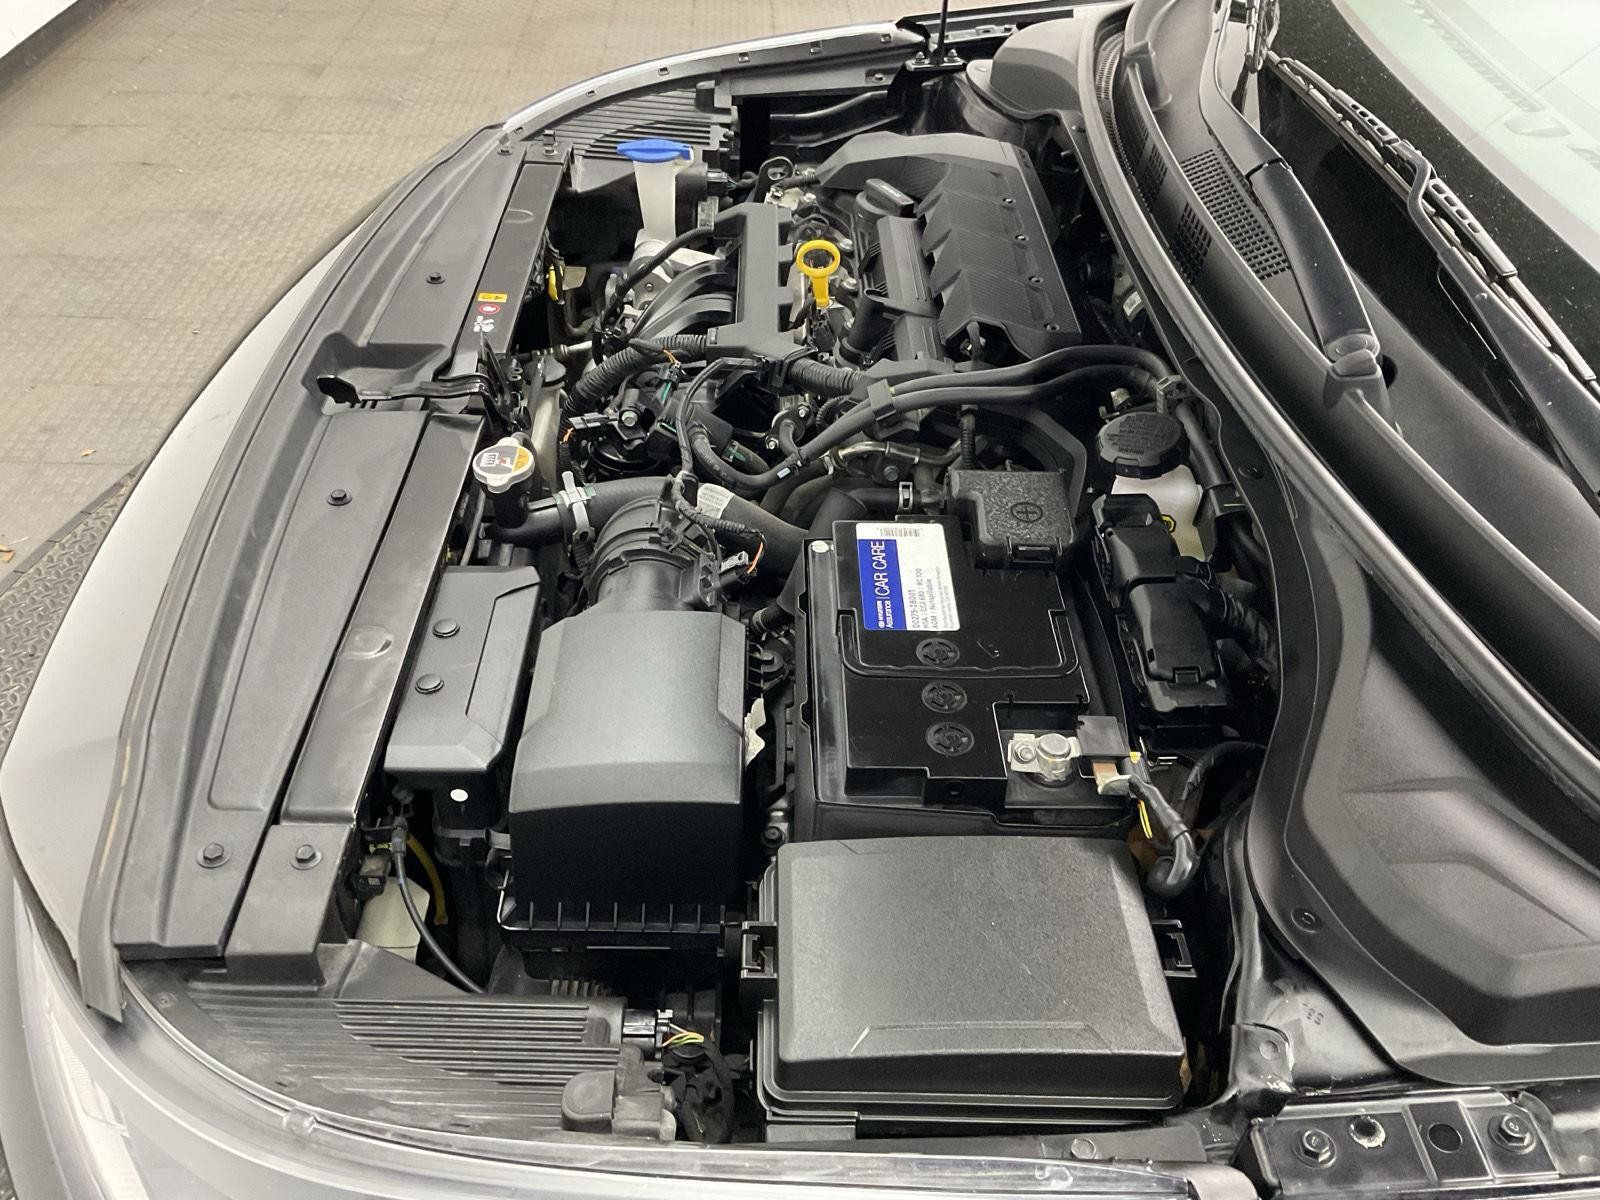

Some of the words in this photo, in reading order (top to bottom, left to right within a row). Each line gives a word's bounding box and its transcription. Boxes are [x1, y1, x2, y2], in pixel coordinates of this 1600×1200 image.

[871, 541, 888, 570] CARE
[873, 572, 890, 596] CAR
[885, 601, 894, 629] Assurance
